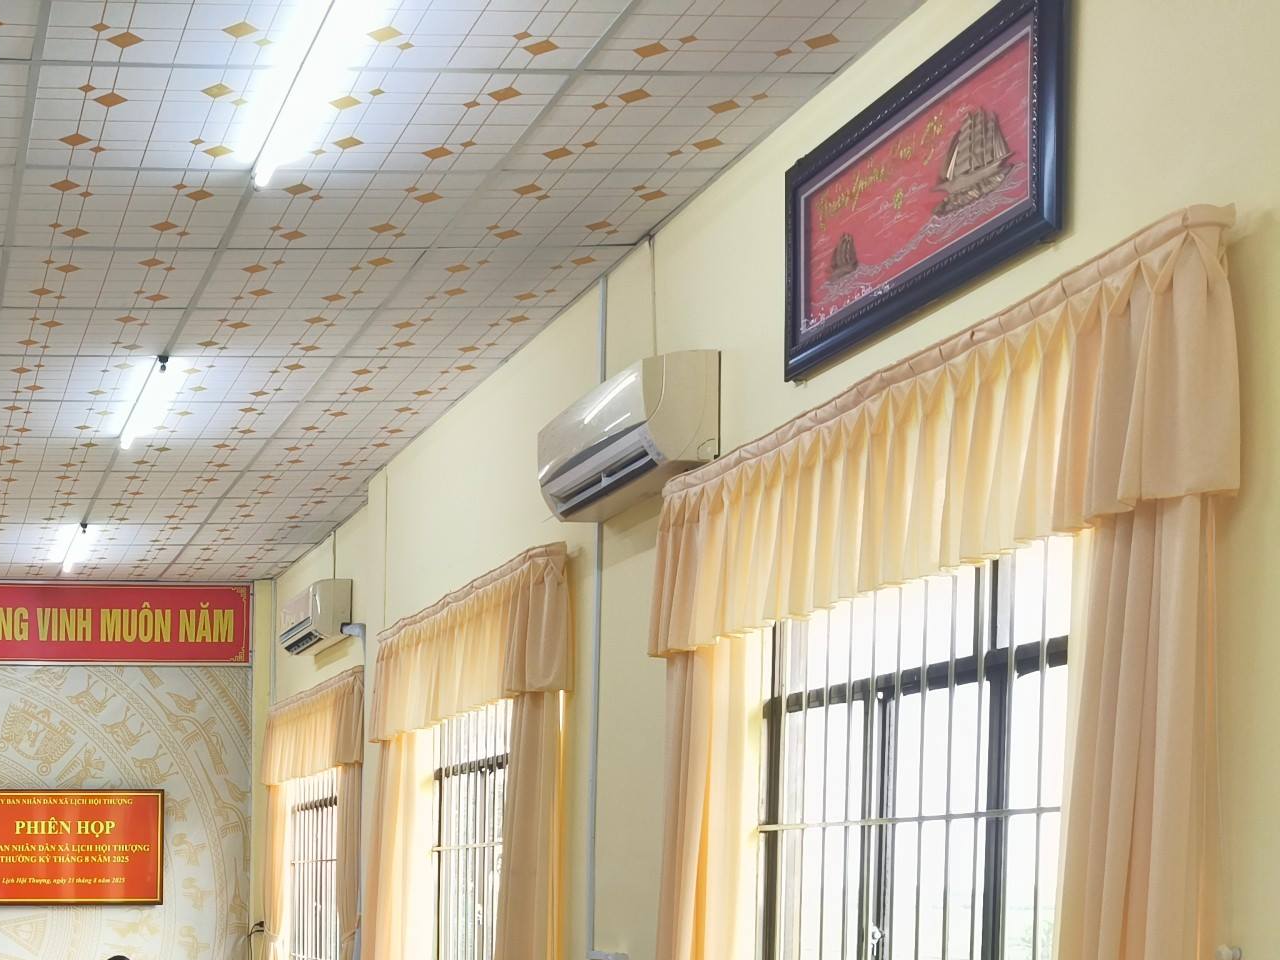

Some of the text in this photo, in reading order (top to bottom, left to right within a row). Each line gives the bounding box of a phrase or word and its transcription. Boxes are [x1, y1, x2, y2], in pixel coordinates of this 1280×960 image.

[36, 607, 92, 642] VINH
[100, 601, 171, 643] MUÔN
[178, 601, 235, 643] NĂM
[15, 816, 116, 838] PHIÊN HỌP
[11, 843, 36, 852] NHÂN
[38, 843, 56, 852] DÂN
[57, 843, 70, 852] XÃ
[71, 844, 93, 853] LỊCH
[95, 843, 111, 853] HỘI
[112, 844, 150, 853] THƯỢNG
[53, 854, 83, 863] THÁNG
[90, 854, 111, 863] NĂM
[112, 855, 130, 863] 2025
